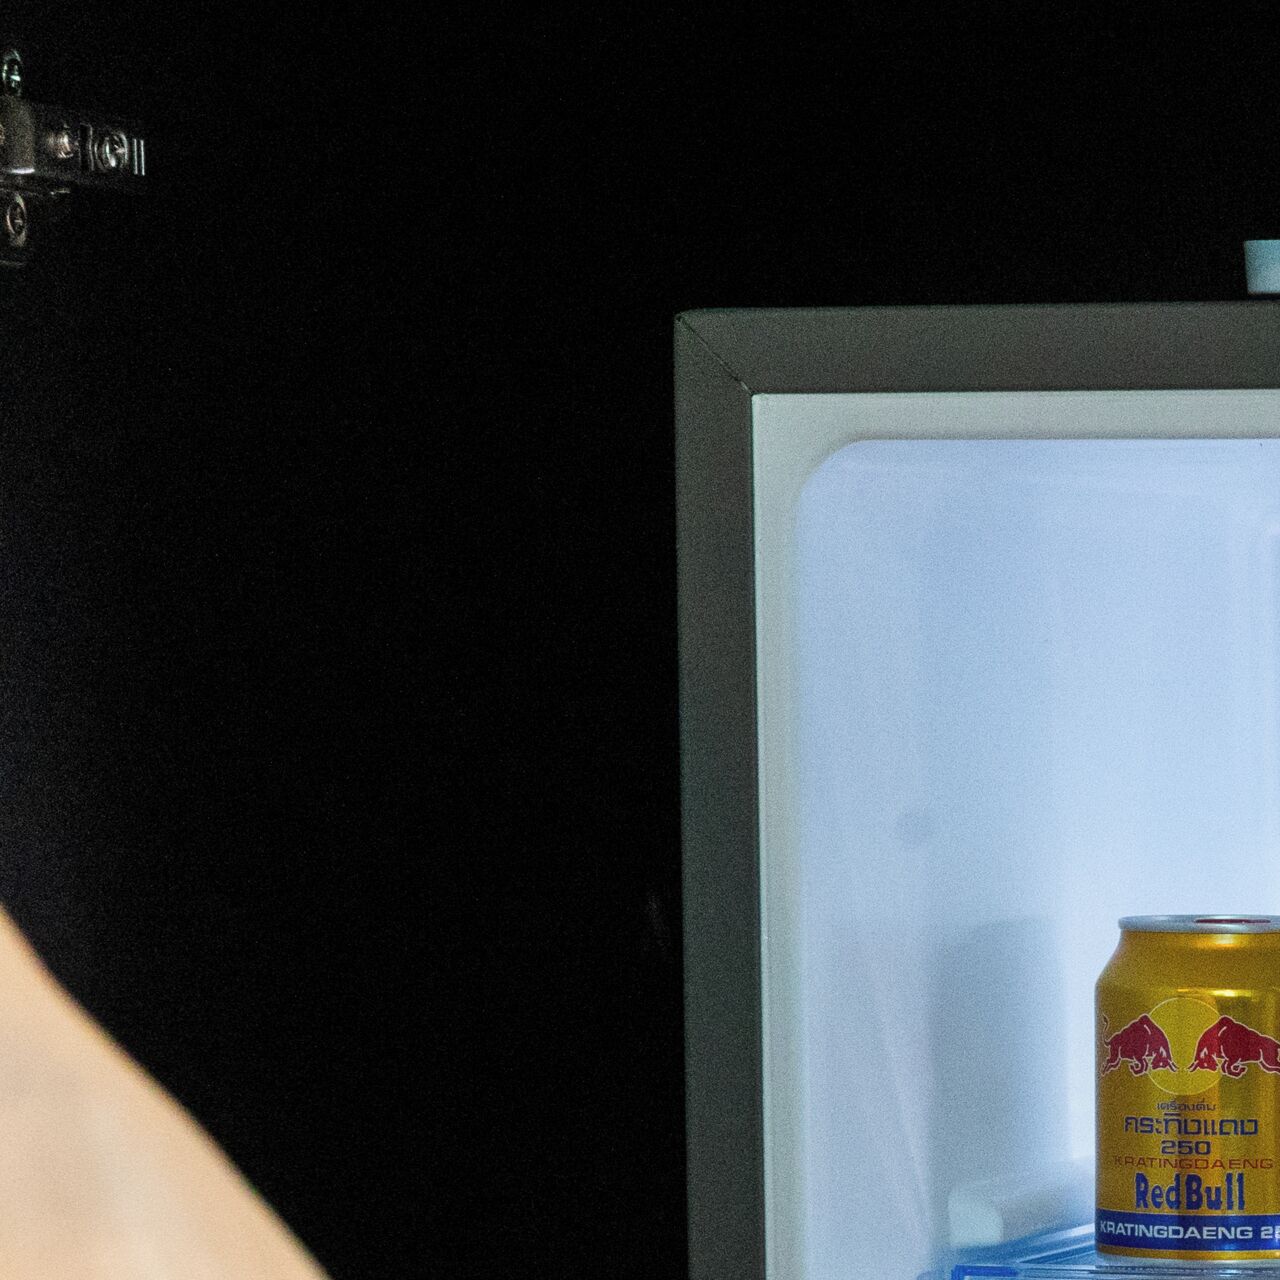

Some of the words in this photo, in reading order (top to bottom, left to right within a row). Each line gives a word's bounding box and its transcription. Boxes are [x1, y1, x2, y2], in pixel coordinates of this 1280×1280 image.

[1124, 1112, 1259, 1136] กระทิงแดง
[1161, 1140, 1211, 1155] 250
[1100, 1221, 1253, 1240] KRATINGDAENG
